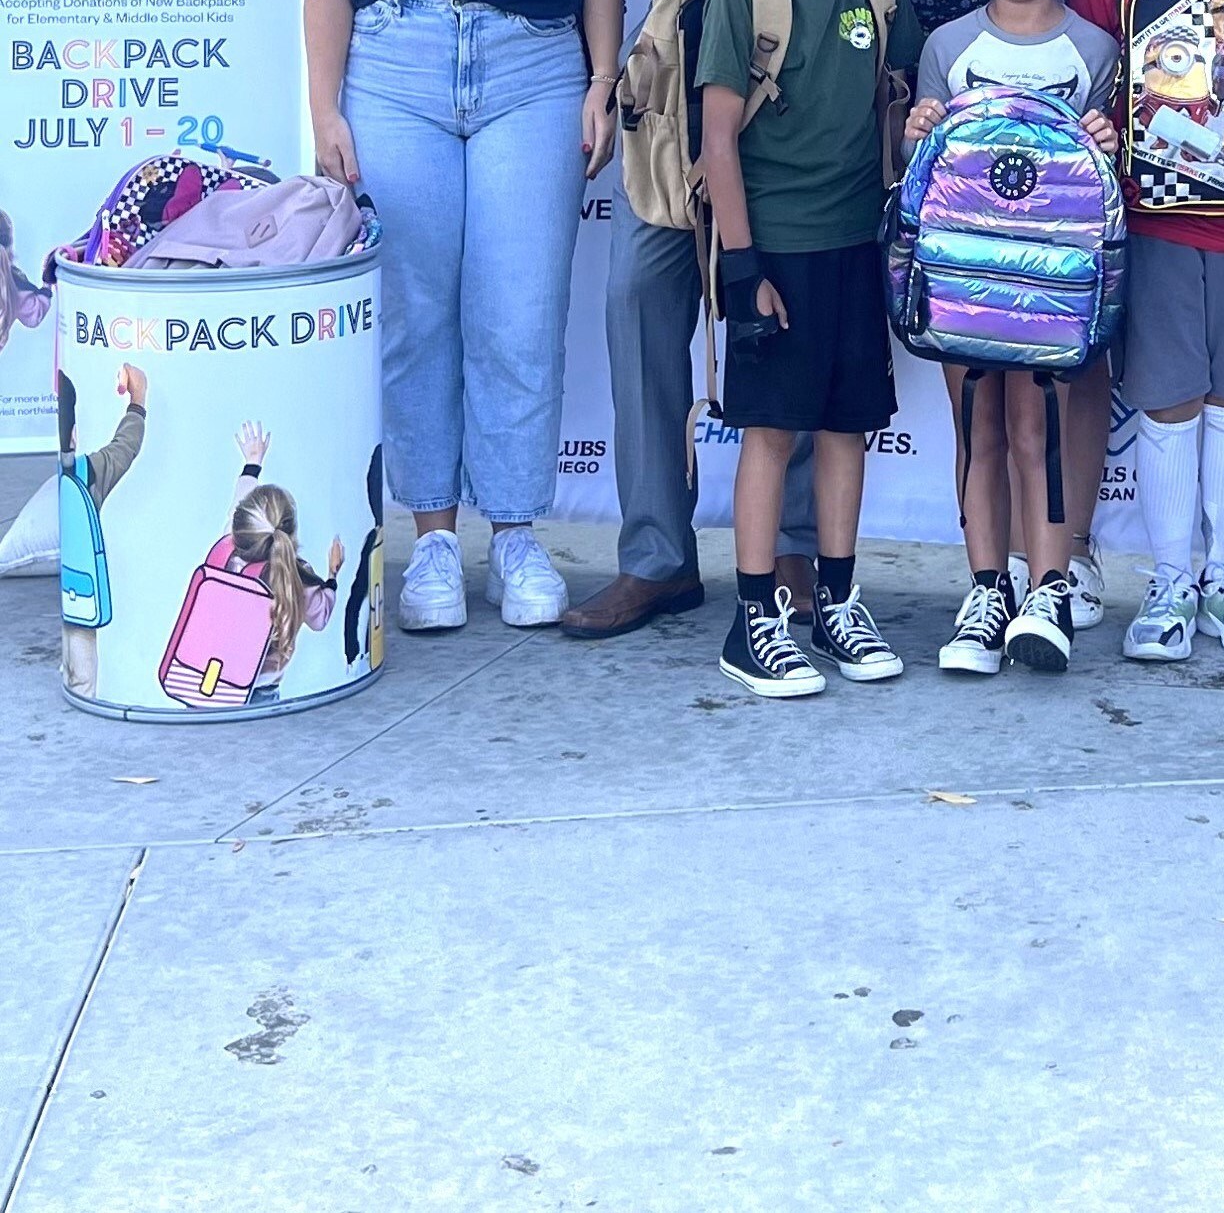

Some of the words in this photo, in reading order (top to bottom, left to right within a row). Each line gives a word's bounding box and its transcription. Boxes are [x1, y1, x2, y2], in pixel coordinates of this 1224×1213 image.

[6, 13, 24, 25] for
[27, 13, 100, 26] Elementary
[103, 12, 113, 24] &
[116, 12, 158, 24] Middle
[160, 11, 204, 23] School
[206, 11, 235, 23] Kids
[11, 38, 231, 71] BACKPACK
[61, 77, 180, 109] DRIVE
[13, 116, 109, 150] JULY
[120, 115, 133, 148] 1
[176, 114, 225, 148] 20
[76, 311, 279, 352] BACKPACK
[291, 298, 373, 345] DRIVE
[558, 440, 606, 457] UBS
[864, 431, 918, 455] VES.
[559, 461, 600, 474] IEGO
[1099, 487, 1136, 501] SAN
